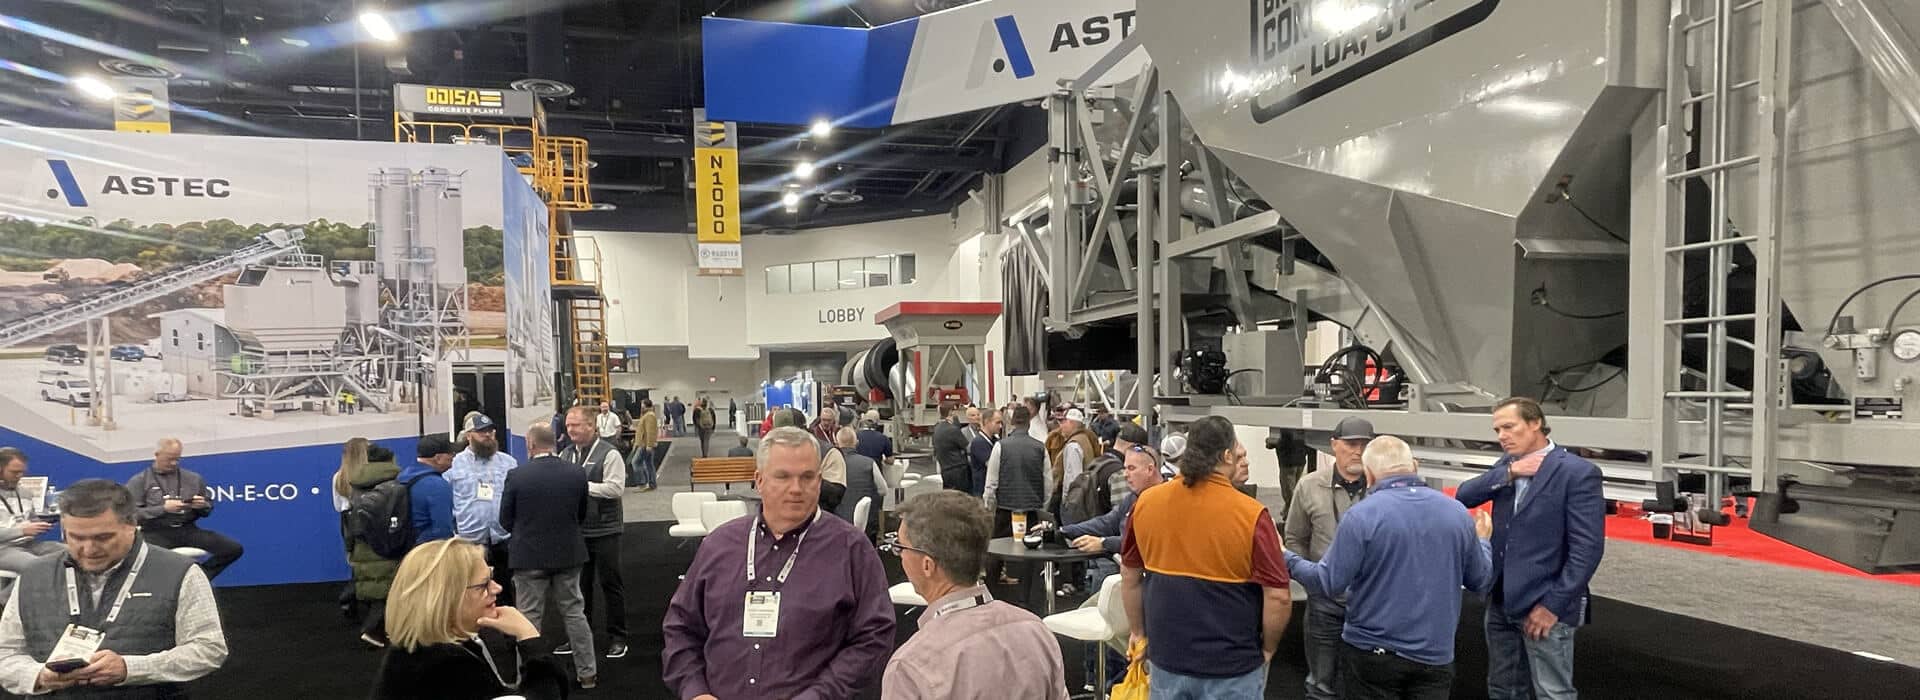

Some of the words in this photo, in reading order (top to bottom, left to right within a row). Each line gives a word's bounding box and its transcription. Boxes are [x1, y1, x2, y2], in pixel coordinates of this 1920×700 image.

[427, 105, 471, 115] CONCRETE
[473, 107, 504, 115] PLANTS
[101, 175, 231, 198] ASTEC
[710, 155, 725, 234] N1000
[818, 307, 865, 324] LOBBY
